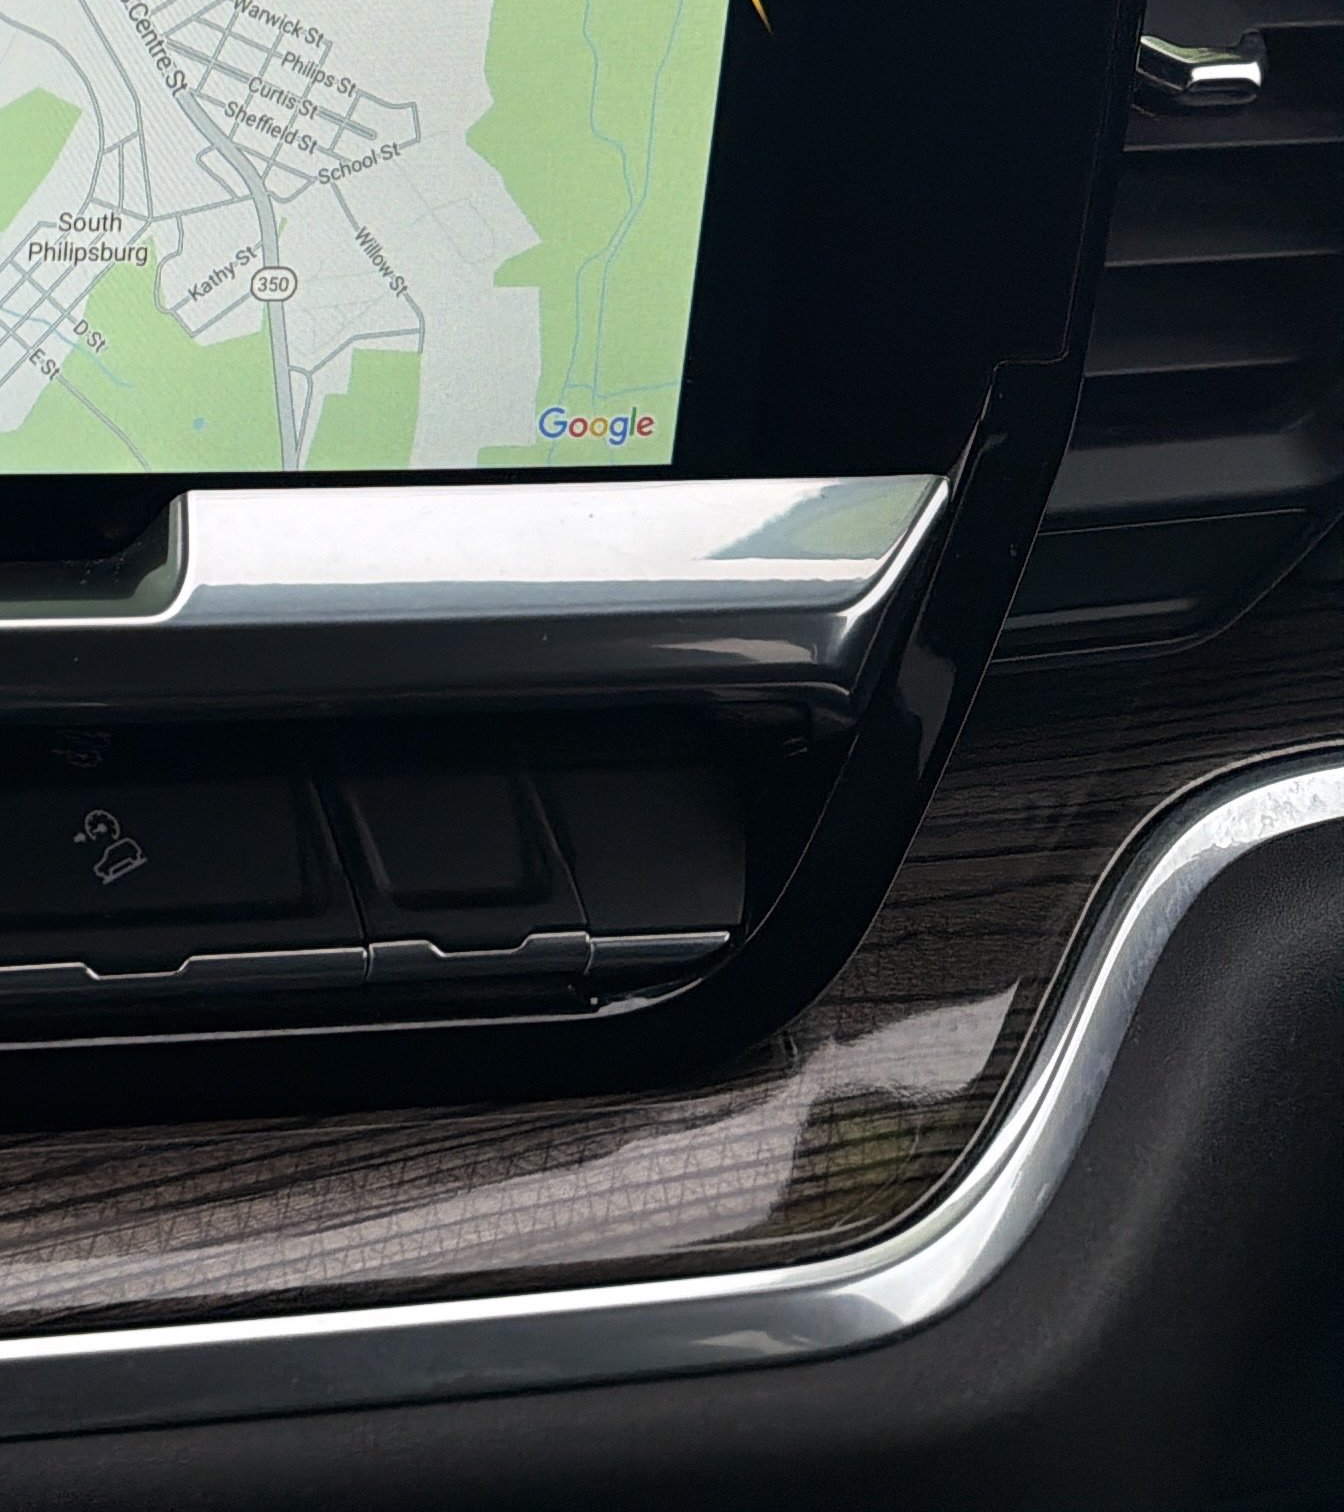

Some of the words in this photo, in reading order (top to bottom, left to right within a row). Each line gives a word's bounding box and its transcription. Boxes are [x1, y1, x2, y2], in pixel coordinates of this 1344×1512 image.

[128, 3, 178, 73] Centre
[165, 70, 188, 97] St
[303, 27, 324, 48] St
[281, 51, 336, 88] Philips
[336, 77, 358, 98] St
[248, 77, 298, 109] Curtis
[298, 99, 319, 119] St
[224, 102, 298, 145] Sheffield
[297, 134, 318, 154] St
[318, 149, 378, 185] School
[378, 142, 401, 163] St
[58, 213, 122, 233] South
[28, 242, 148, 266] Philipsburg
[356, 226, 399, 282] Willow
[389, 275, 408, 298] St
[188, 265, 235, 302] Kathy
[234, 247, 257, 269] St
[257, 277, 289, 292] 350
[73, 319, 87, 336] D
[86, 330, 106, 353] St
[29, 348, 43, 365] E
[39, 357, 60, 380] St
[538, 407, 654, 446] Google
